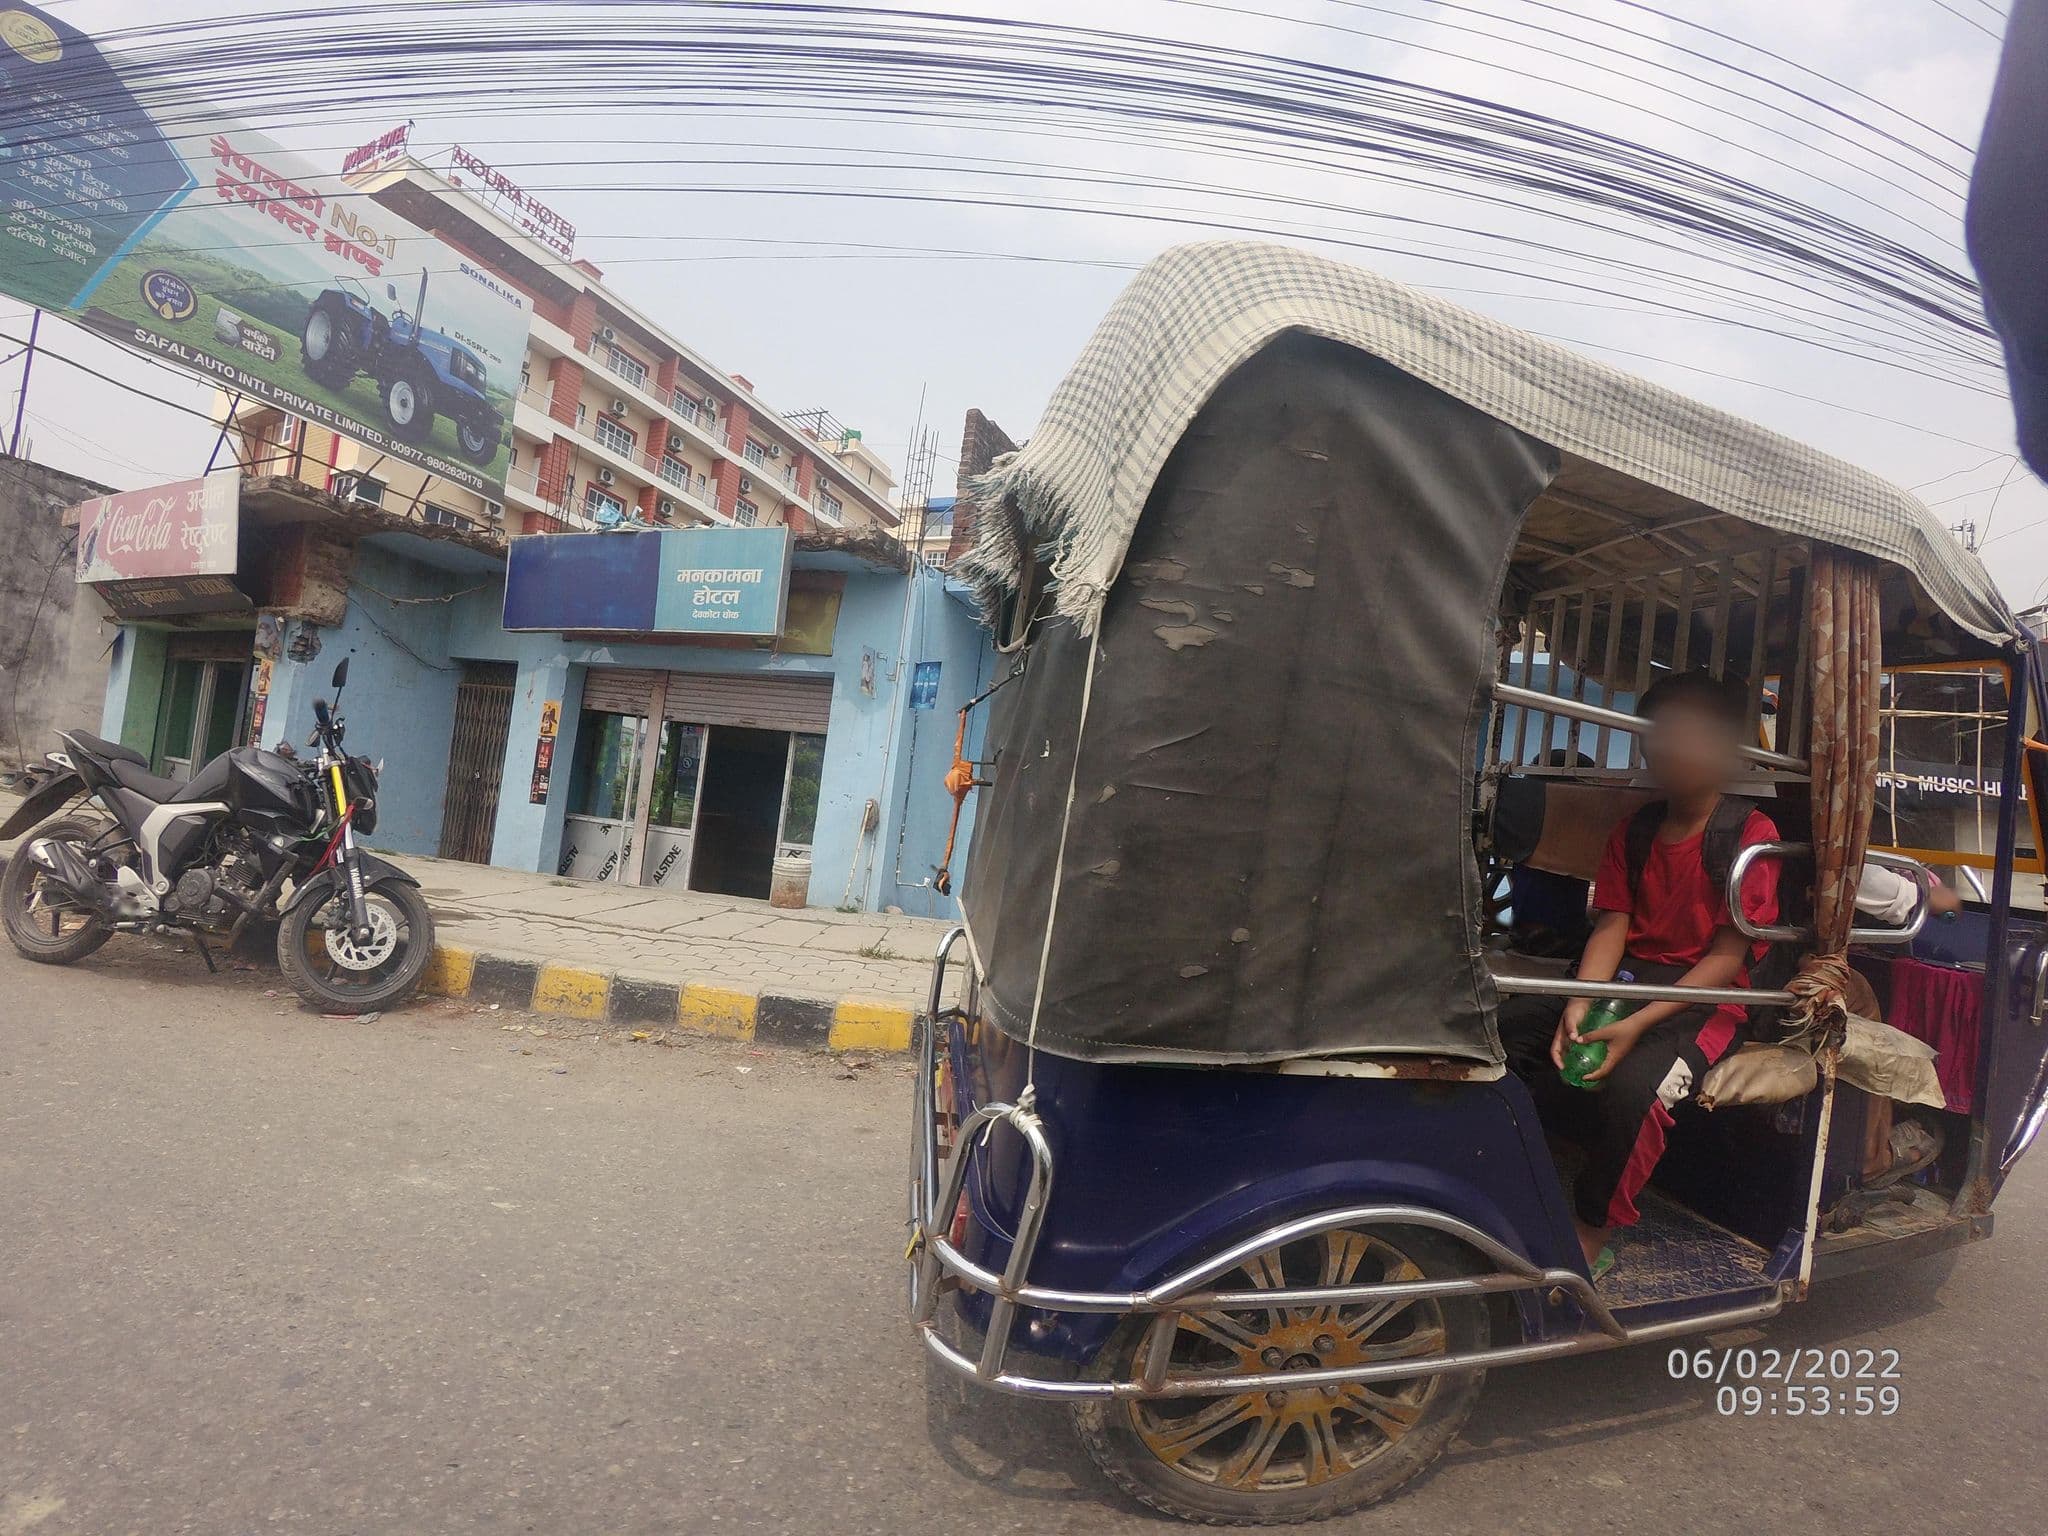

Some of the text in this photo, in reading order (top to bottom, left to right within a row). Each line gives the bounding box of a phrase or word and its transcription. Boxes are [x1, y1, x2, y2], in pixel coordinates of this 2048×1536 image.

[454, 145, 576, 241] MOURYA HOTEL
[331, 201, 396, 261] No.1
[460, 262, 522, 310] SONALIKA
[134, 328, 190, 360] SAFAL
[194, 352, 236, 379] AUTO
[238, 371, 270, 395] INTL
[273, 389, 333, 421] PRIVATE
[391, 440, 483, 489] 00977-9802620178
[677, 568, 764, 584] मनकामना
[692, 585, 741, 606] होटल
[1919, 775, 1975, 794] MUSIC
[653, 844, 682, 885] ALSTONE
